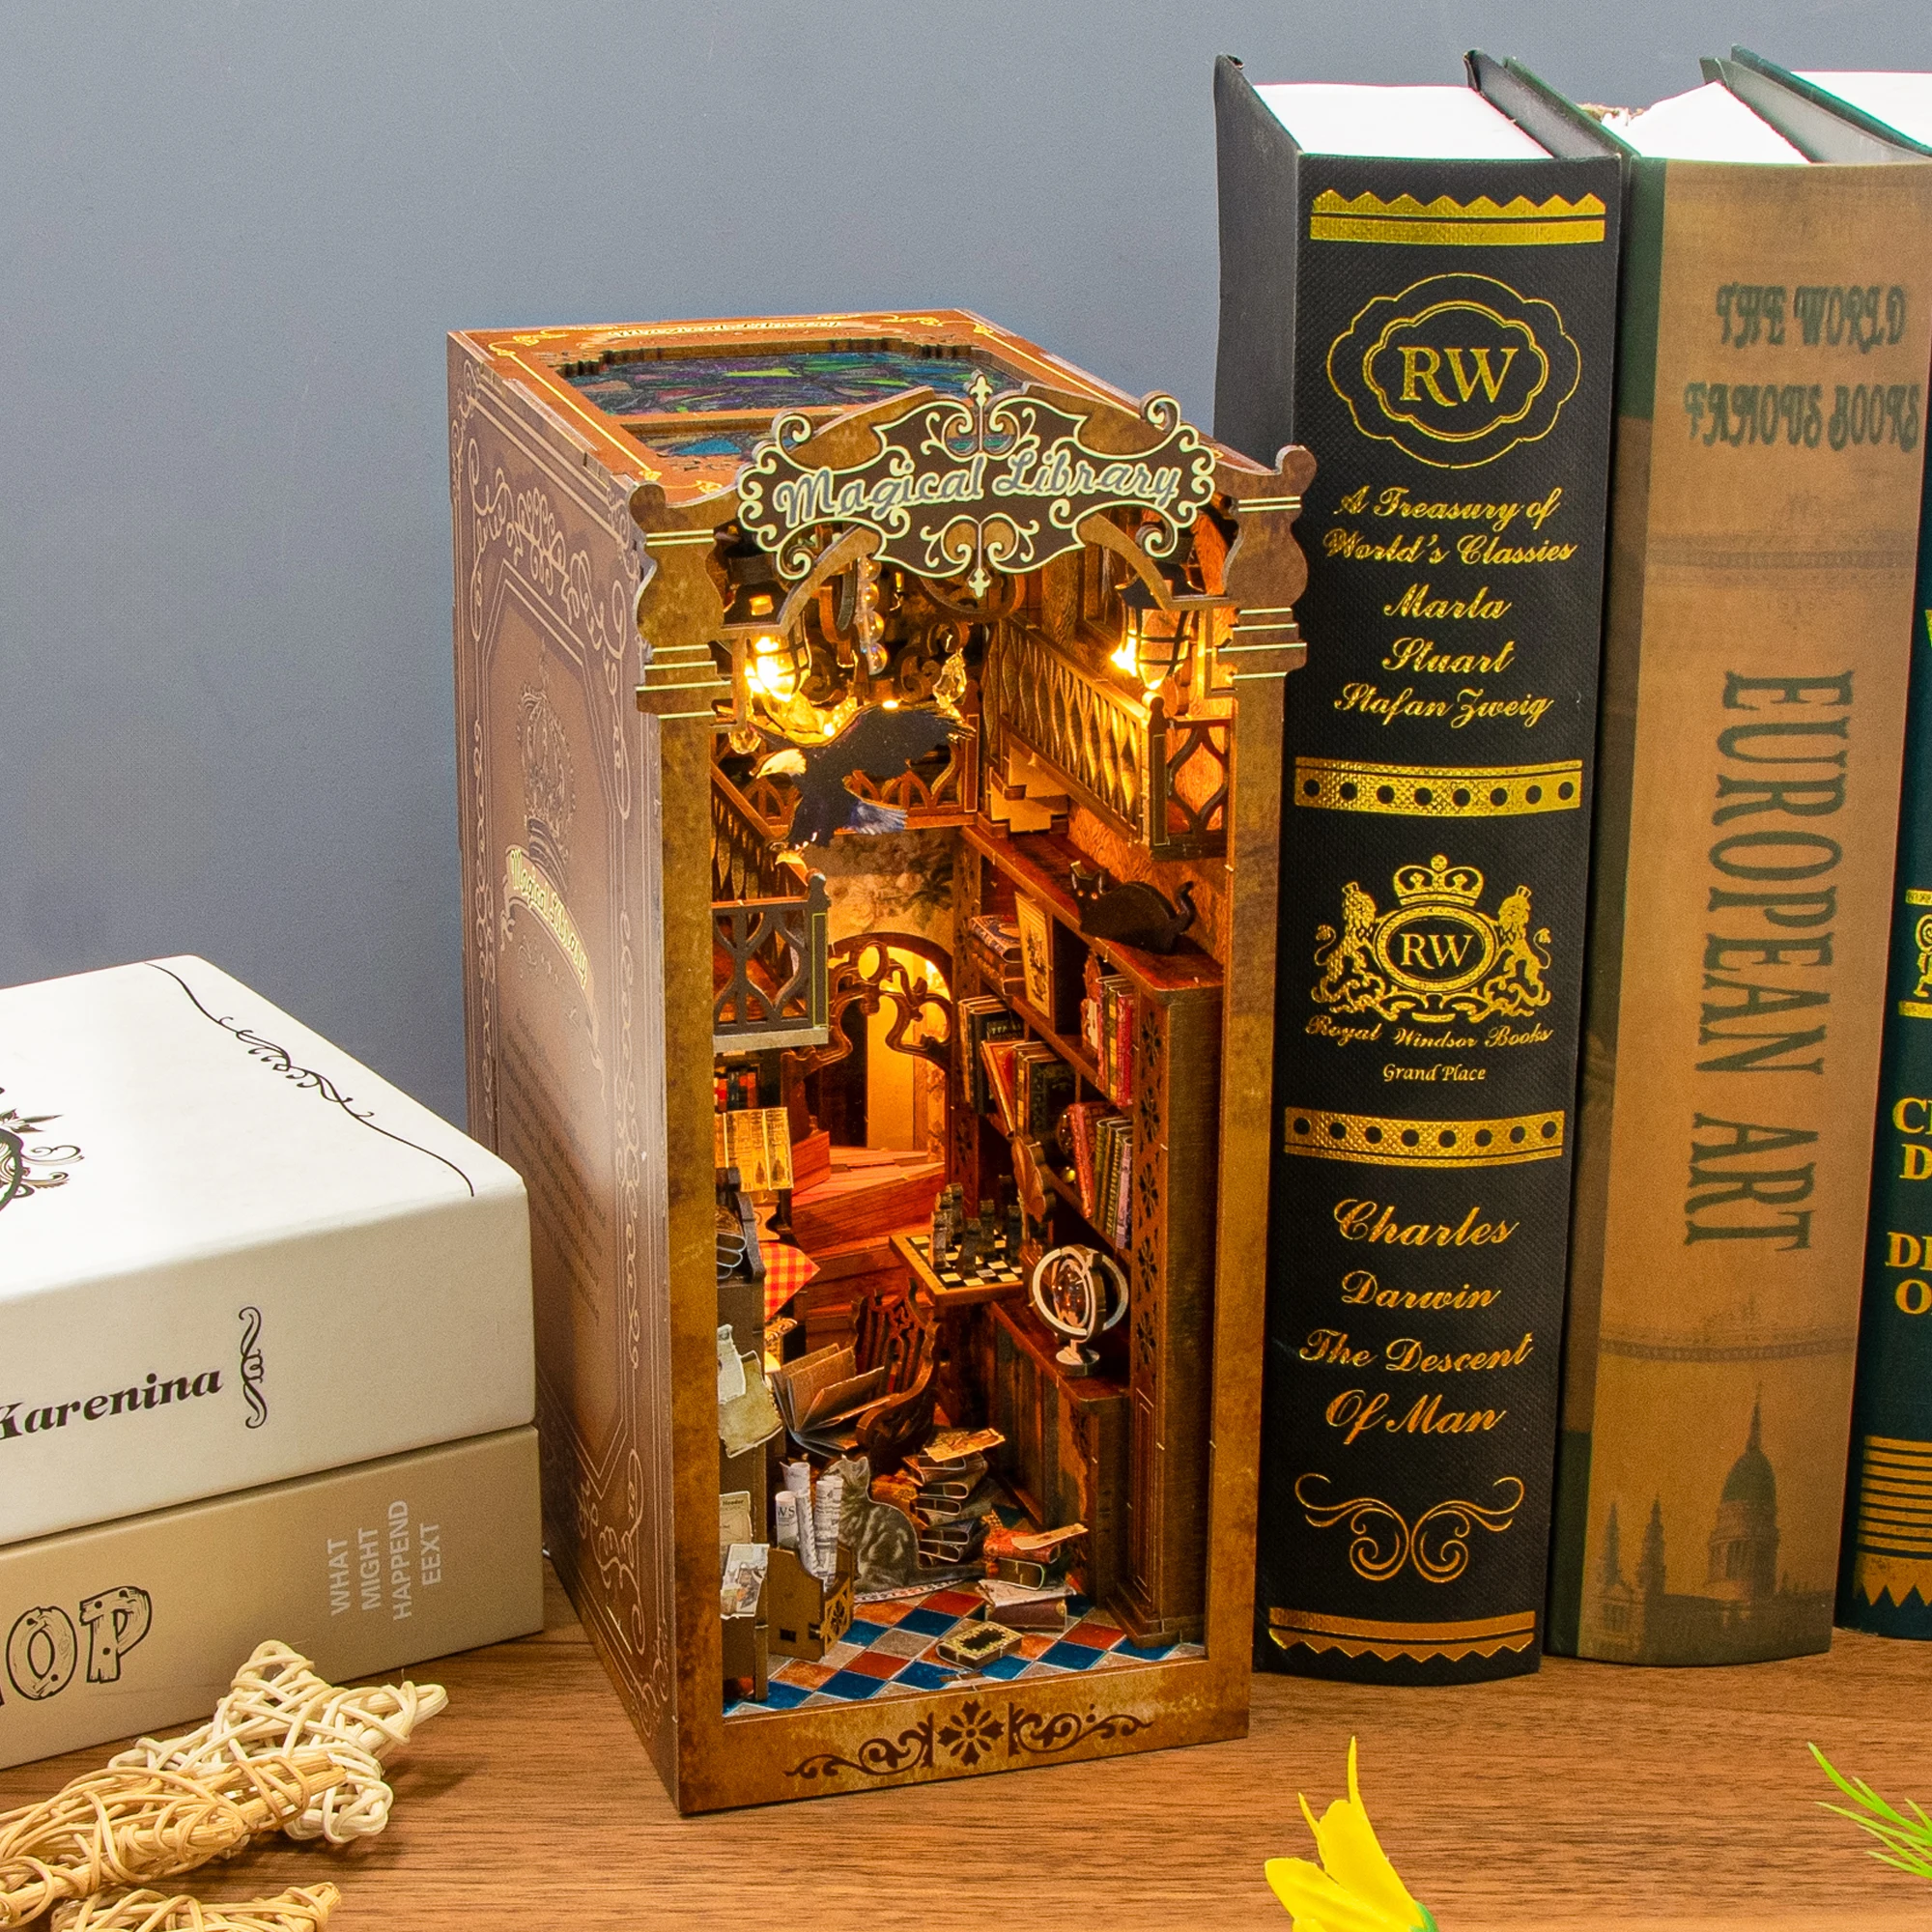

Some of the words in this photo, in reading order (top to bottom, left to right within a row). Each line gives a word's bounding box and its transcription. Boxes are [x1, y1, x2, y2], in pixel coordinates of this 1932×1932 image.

[1398, 346, 1520, 407] RW
[775, 454, 985, 527] Magical
[993, 448, 1181, 507] Library
[1333, 486, 1370, 514] A
[1373, 486, 1524, 531] Treasury
[1525, 487, 1561, 530] of
[1383, 582, 1513, 619] Marla
[1381, 637, 1516, 674] Stuart
[1334, 682, 1453, 725] Stafan
[1450, 687, 1555, 728] Zweig
[1695, 669, 1854, 1075] EUROPEAN
[1399, 933, 1474, 968] RW
[1305, 1015, 1382, 1046] Royal
[1394, 1027, 1478, 1048] Windsor
[1485, 1023, 1554, 1048] Books
[1383, 1064, 1442, 1082] Grand
[1441, 1064, 1487, 1081] Place
[1684, 1112, 1820, 1252] ART
[1333, 1199, 1520, 1246] Charles
[1341, 1270, 1501, 1309] Darwin
[1299, 1328, 1378, 1367] The
[1385, 1332, 1534, 1373] Descent
[1325, 1389, 1389, 1445] Of
[1385, 1394, 1507, 1435] Man
[327, 1538, 351, 1616] WHAT
[358, 1527, 382, 1610] MIGHT
[388, 1499, 412, 1621] HAPPEND
[420, 1522, 441, 1586] EEXT
[0, 1585, 153, 1707] OP
